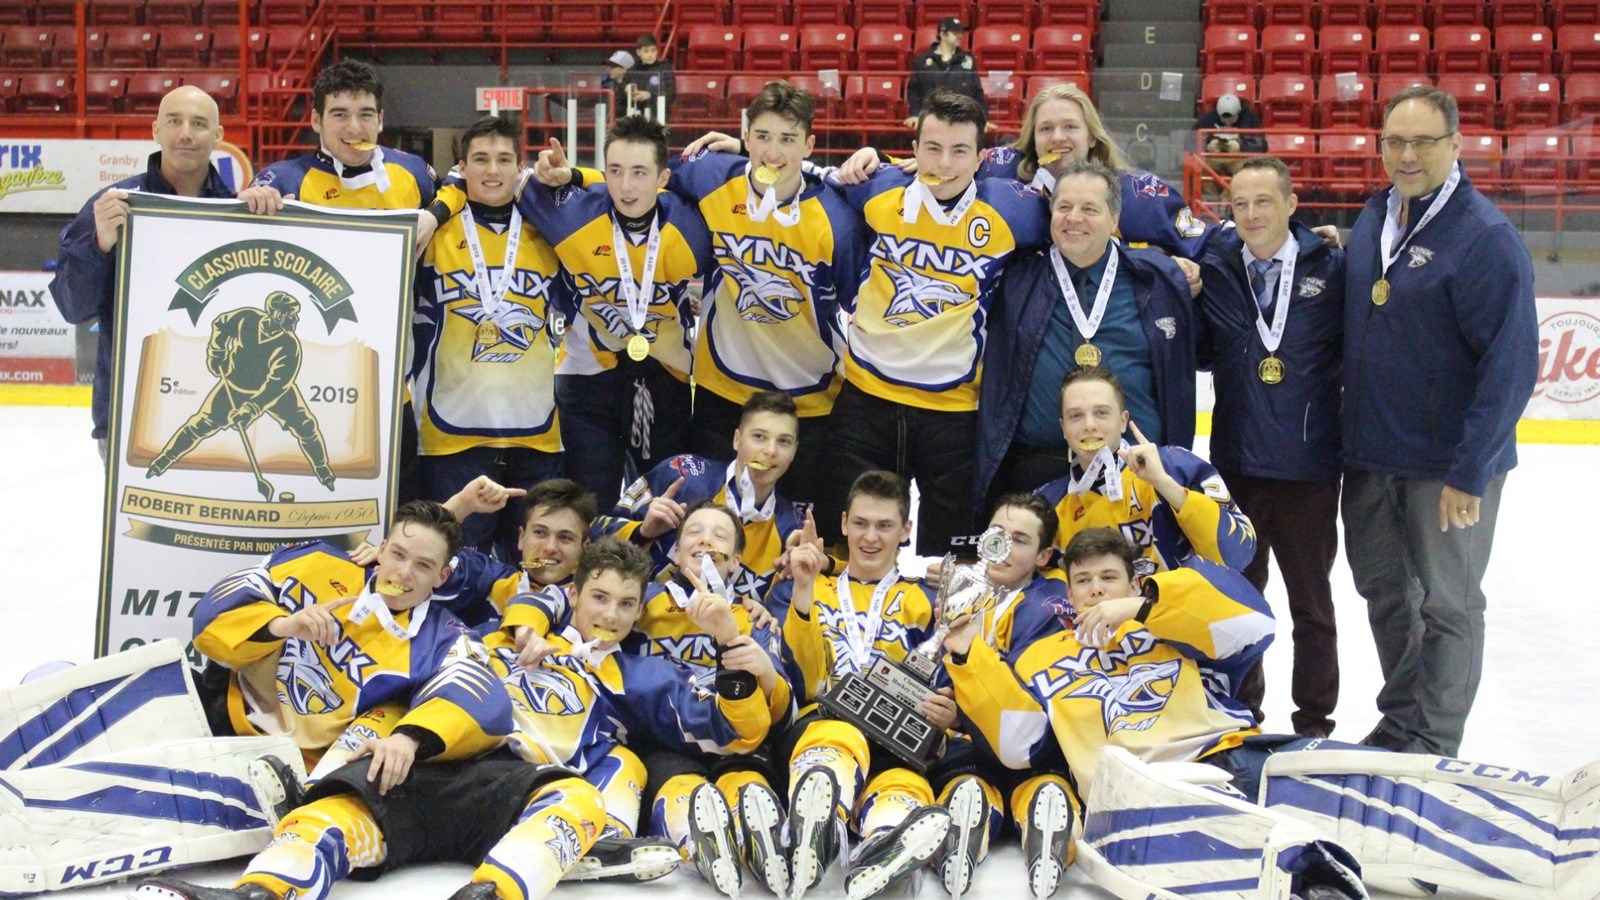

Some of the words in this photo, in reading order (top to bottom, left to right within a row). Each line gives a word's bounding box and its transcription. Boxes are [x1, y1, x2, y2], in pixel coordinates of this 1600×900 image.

[1145, 27, 1156, 43] E
[1141, 72, 1152, 90] D
[1136, 123, 1148, 141] C
[99, 154, 139, 168] Granby
[968, 216, 991, 248] C
[187, 248, 270, 291] CLASSIQUE
[273, 250, 343, 300] SCOLAIRE
[11, 326, 68, 335] nouveaux
[173, 388, 197, 396] édition
[309, 385, 359, 404] 2019
[1553, 386, 1583, 398] DEPUIS
[1128, 481, 1143, 516] A
[127, 494, 194, 516] ROBERT
[200, 506, 281, 523] BERNARD
[288, 508, 332, 526] Depuis
[334, 507, 375, 521] 1950
[174, 533, 231, 550] PRÉSENTÉE
[233, 540, 253, 552] PAR
[951, 536, 980, 546] CC
[891, 678, 910, 693] Hockey
[902, 676, 927, 695] Classique
[1434, 757, 1550, 788] CCM
[60, 845, 173, 884] CCM
